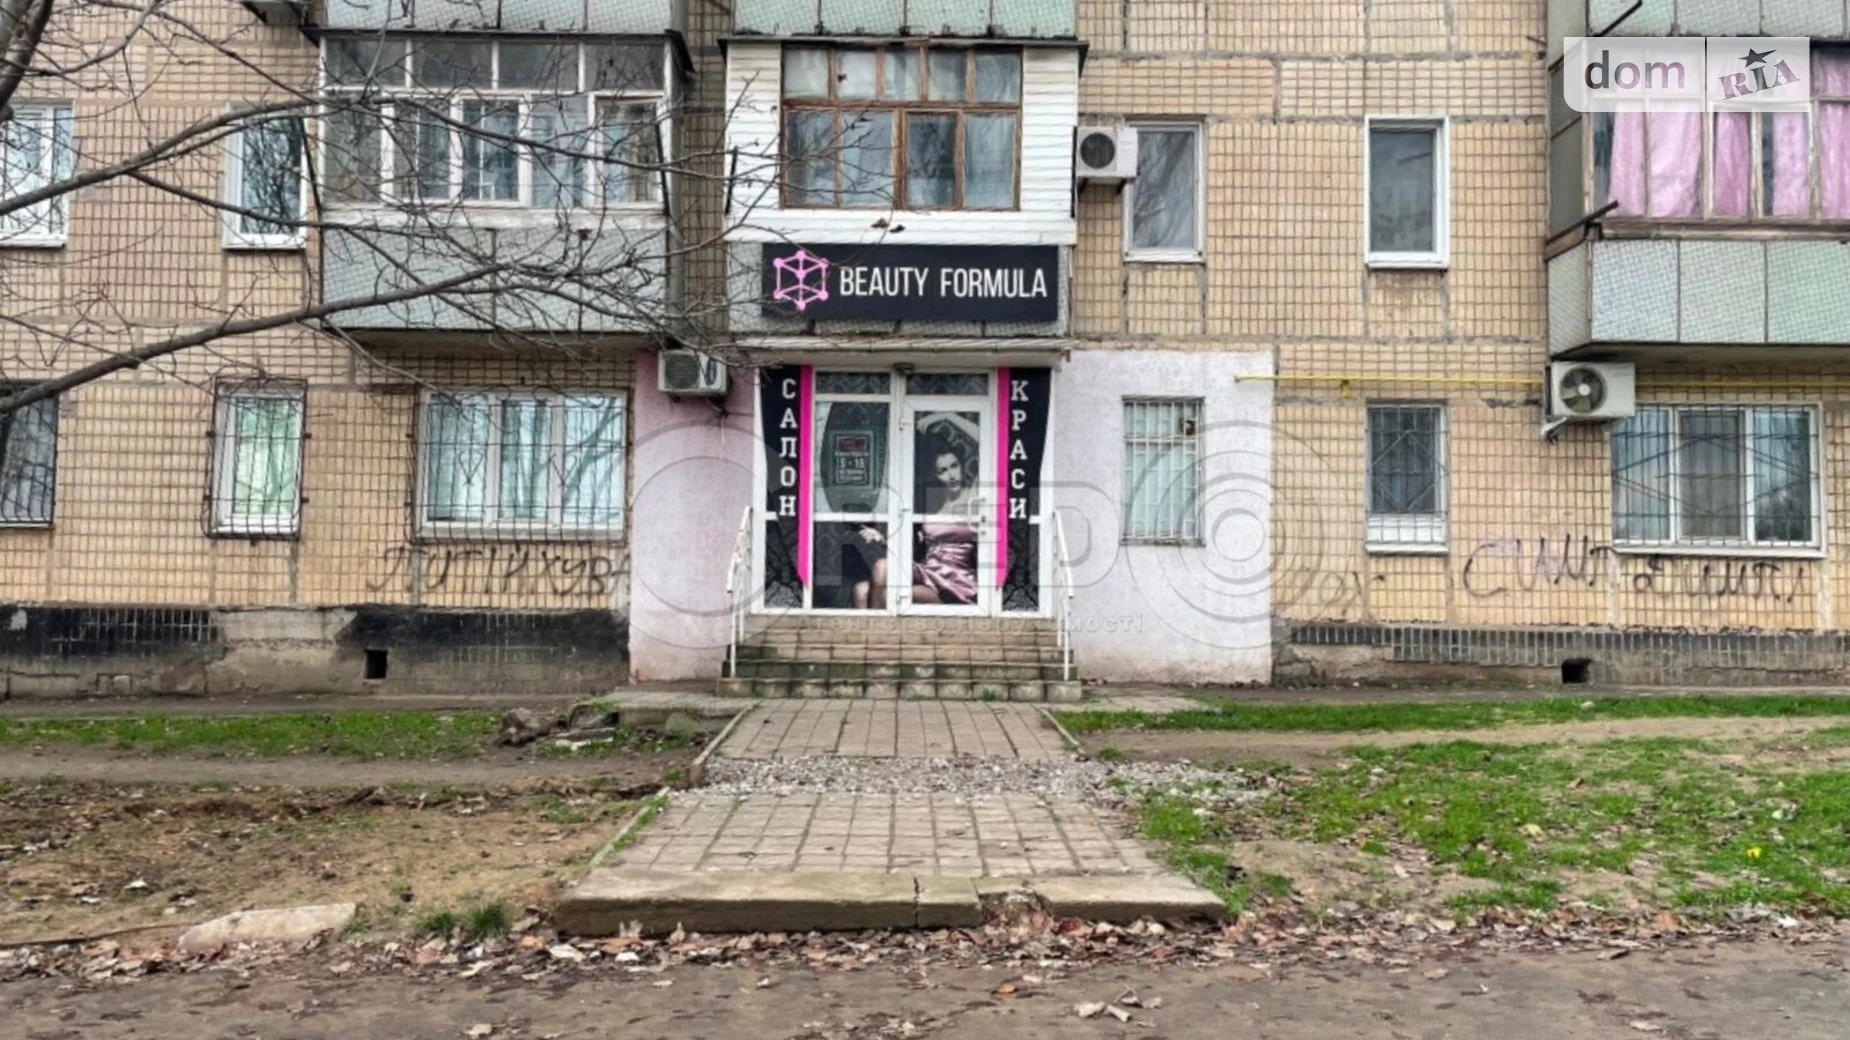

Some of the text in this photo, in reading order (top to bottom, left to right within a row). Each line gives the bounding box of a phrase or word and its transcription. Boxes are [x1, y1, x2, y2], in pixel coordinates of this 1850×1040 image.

[839, 266, 1047, 298] BEAUTY FORMULA
[778, 378, 799, 517] САЛОН
[1009, 380, 1029, 520] КРАСИ
